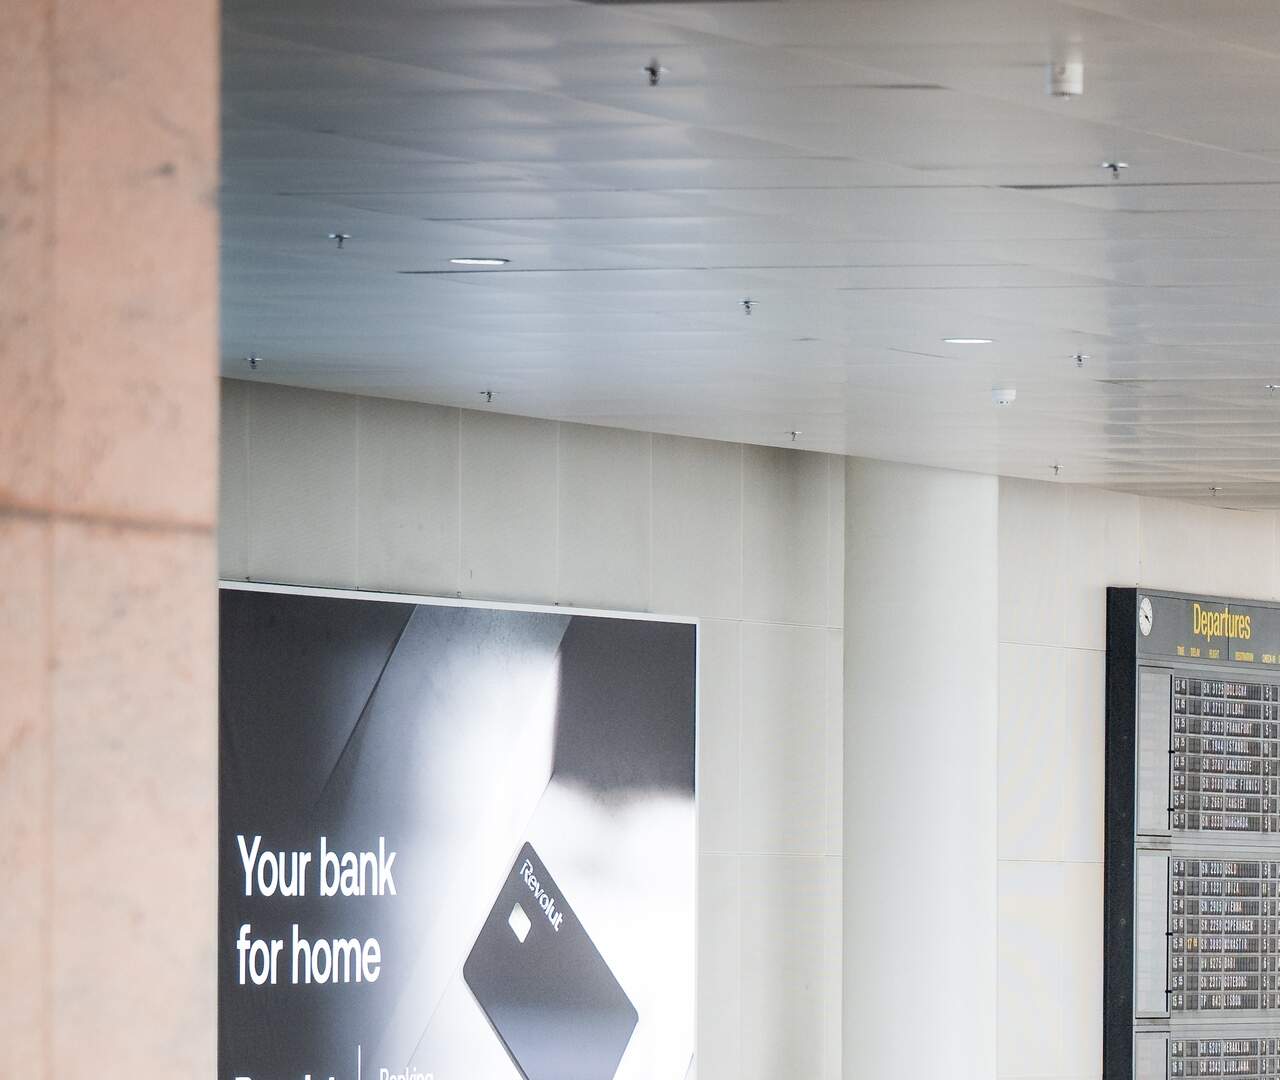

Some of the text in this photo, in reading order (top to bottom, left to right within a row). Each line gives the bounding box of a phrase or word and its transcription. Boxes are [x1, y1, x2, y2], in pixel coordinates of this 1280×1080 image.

[1193, 603, 1251, 643] Departures
[1226, 719, 1252, 734] FRANKFURT
[1226, 739, 1249, 753] ISTANBUL
[1226, 757, 1252, 772] LANZAROTE
[237, 835, 397, 897] Your bank
[520, 859, 566, 932] Revolut
[1224, 920, 1253, 931] COPENHAGEN
[237, 924, 381, 984] for home
[1224, 995, 1241, 1006] LISBON
